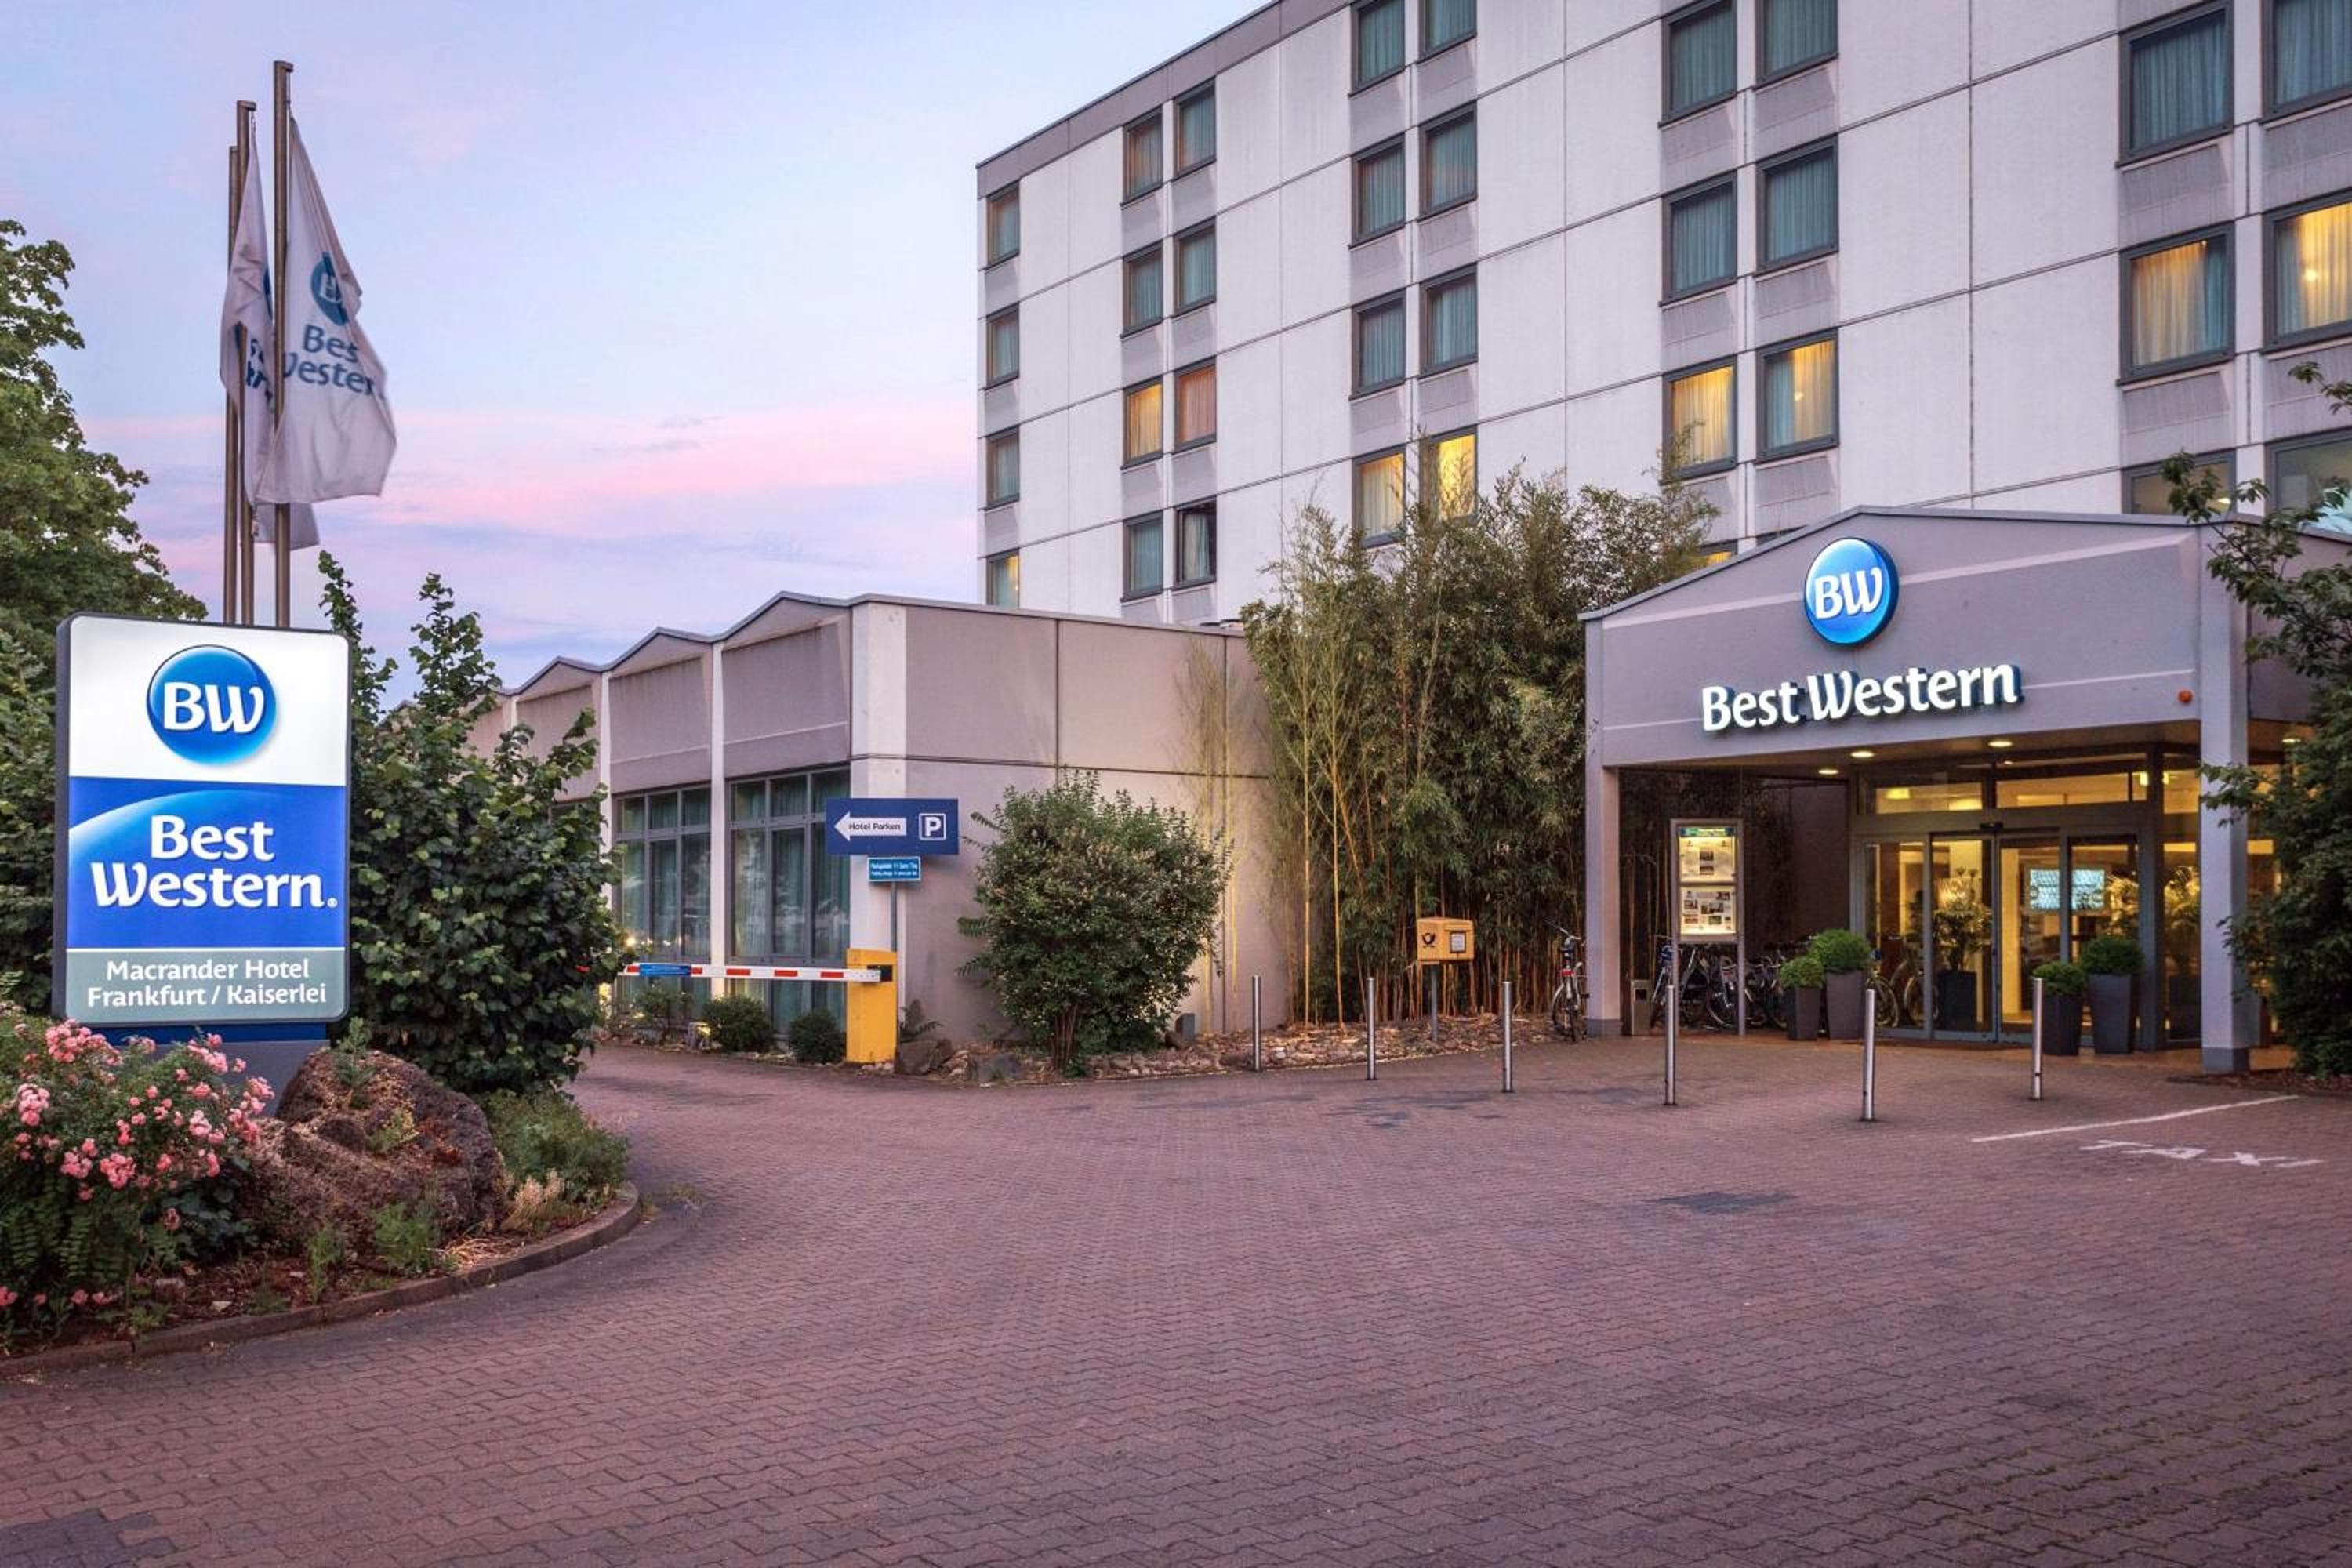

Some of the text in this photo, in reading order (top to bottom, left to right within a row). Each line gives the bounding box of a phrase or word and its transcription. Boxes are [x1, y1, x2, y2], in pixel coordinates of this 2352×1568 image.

[303, 324, 360, 364] Bes
[283, 351, 376, 397] ester
[1814, 567, 1882, 620] BW
[163, 680, 265, 734] BW
[1702, 663, 2020, 731] Best Western
[151, 815, 274, 861] Best
[849, 822, 870, 831] Hotel
[924, 816, 942, 837] P
[106, 957, 310, 982] Macrander Hotel
[86, 984, 207, 1008] Frankfurt
[227, 982, 328, 1005] Kaiserlei
